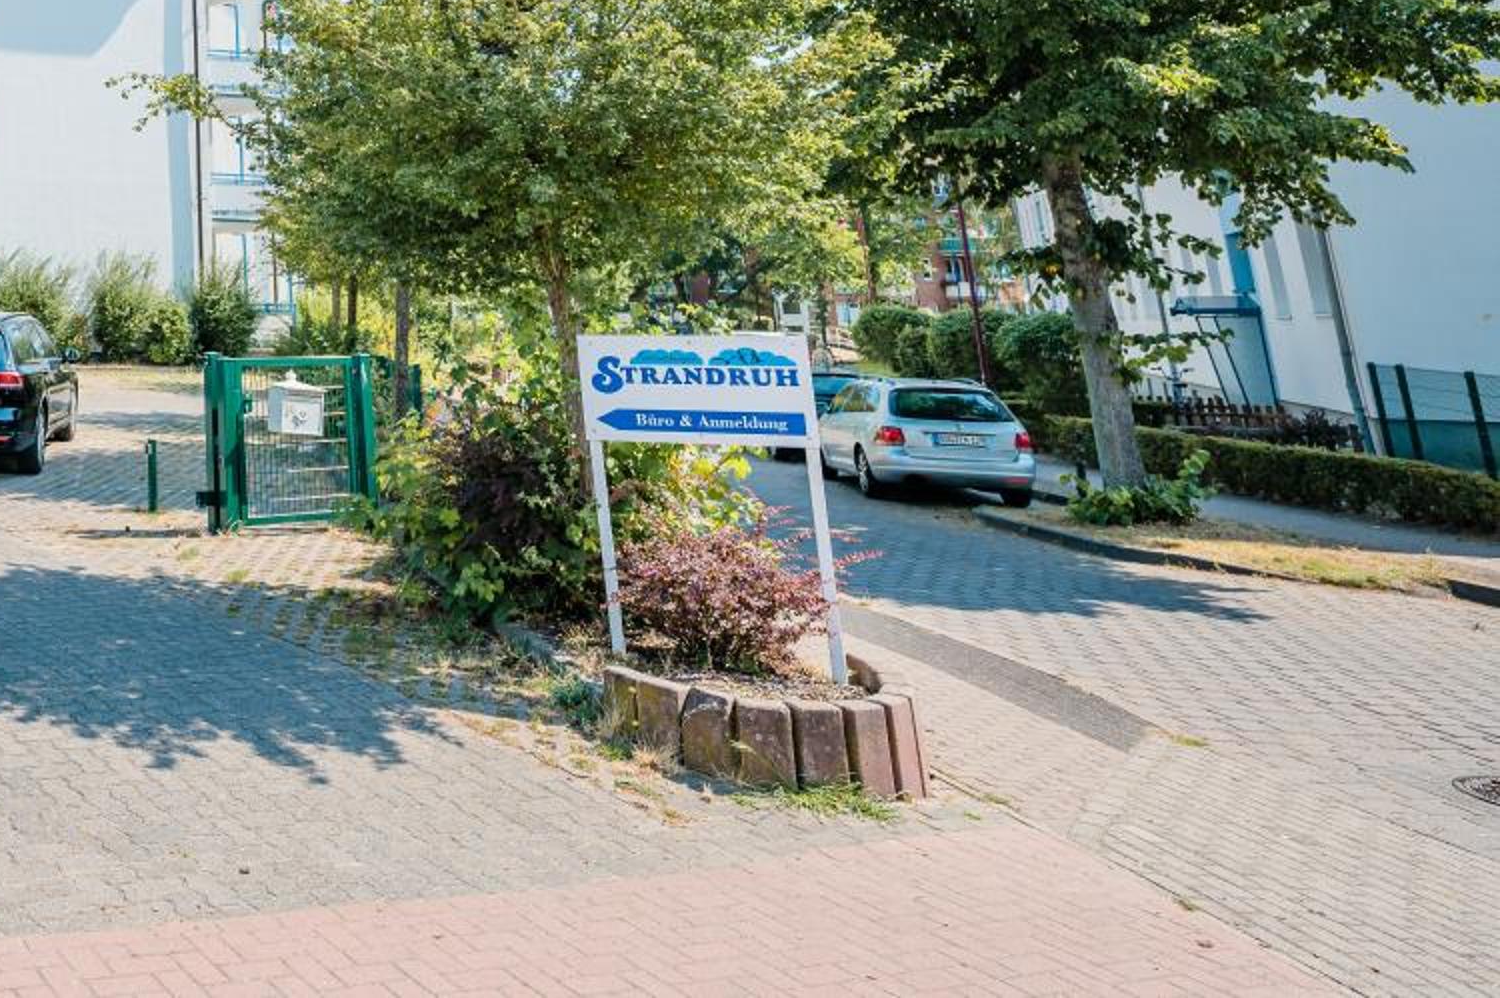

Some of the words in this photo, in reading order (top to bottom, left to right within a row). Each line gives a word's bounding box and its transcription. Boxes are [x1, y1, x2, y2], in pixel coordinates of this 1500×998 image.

[592, 356, 799, 394] STRANDRUH
[635, 413, 674, 427] Büro
[679, 414, 693, 427] &
[699, 413, 789, 431] Anmeldung
